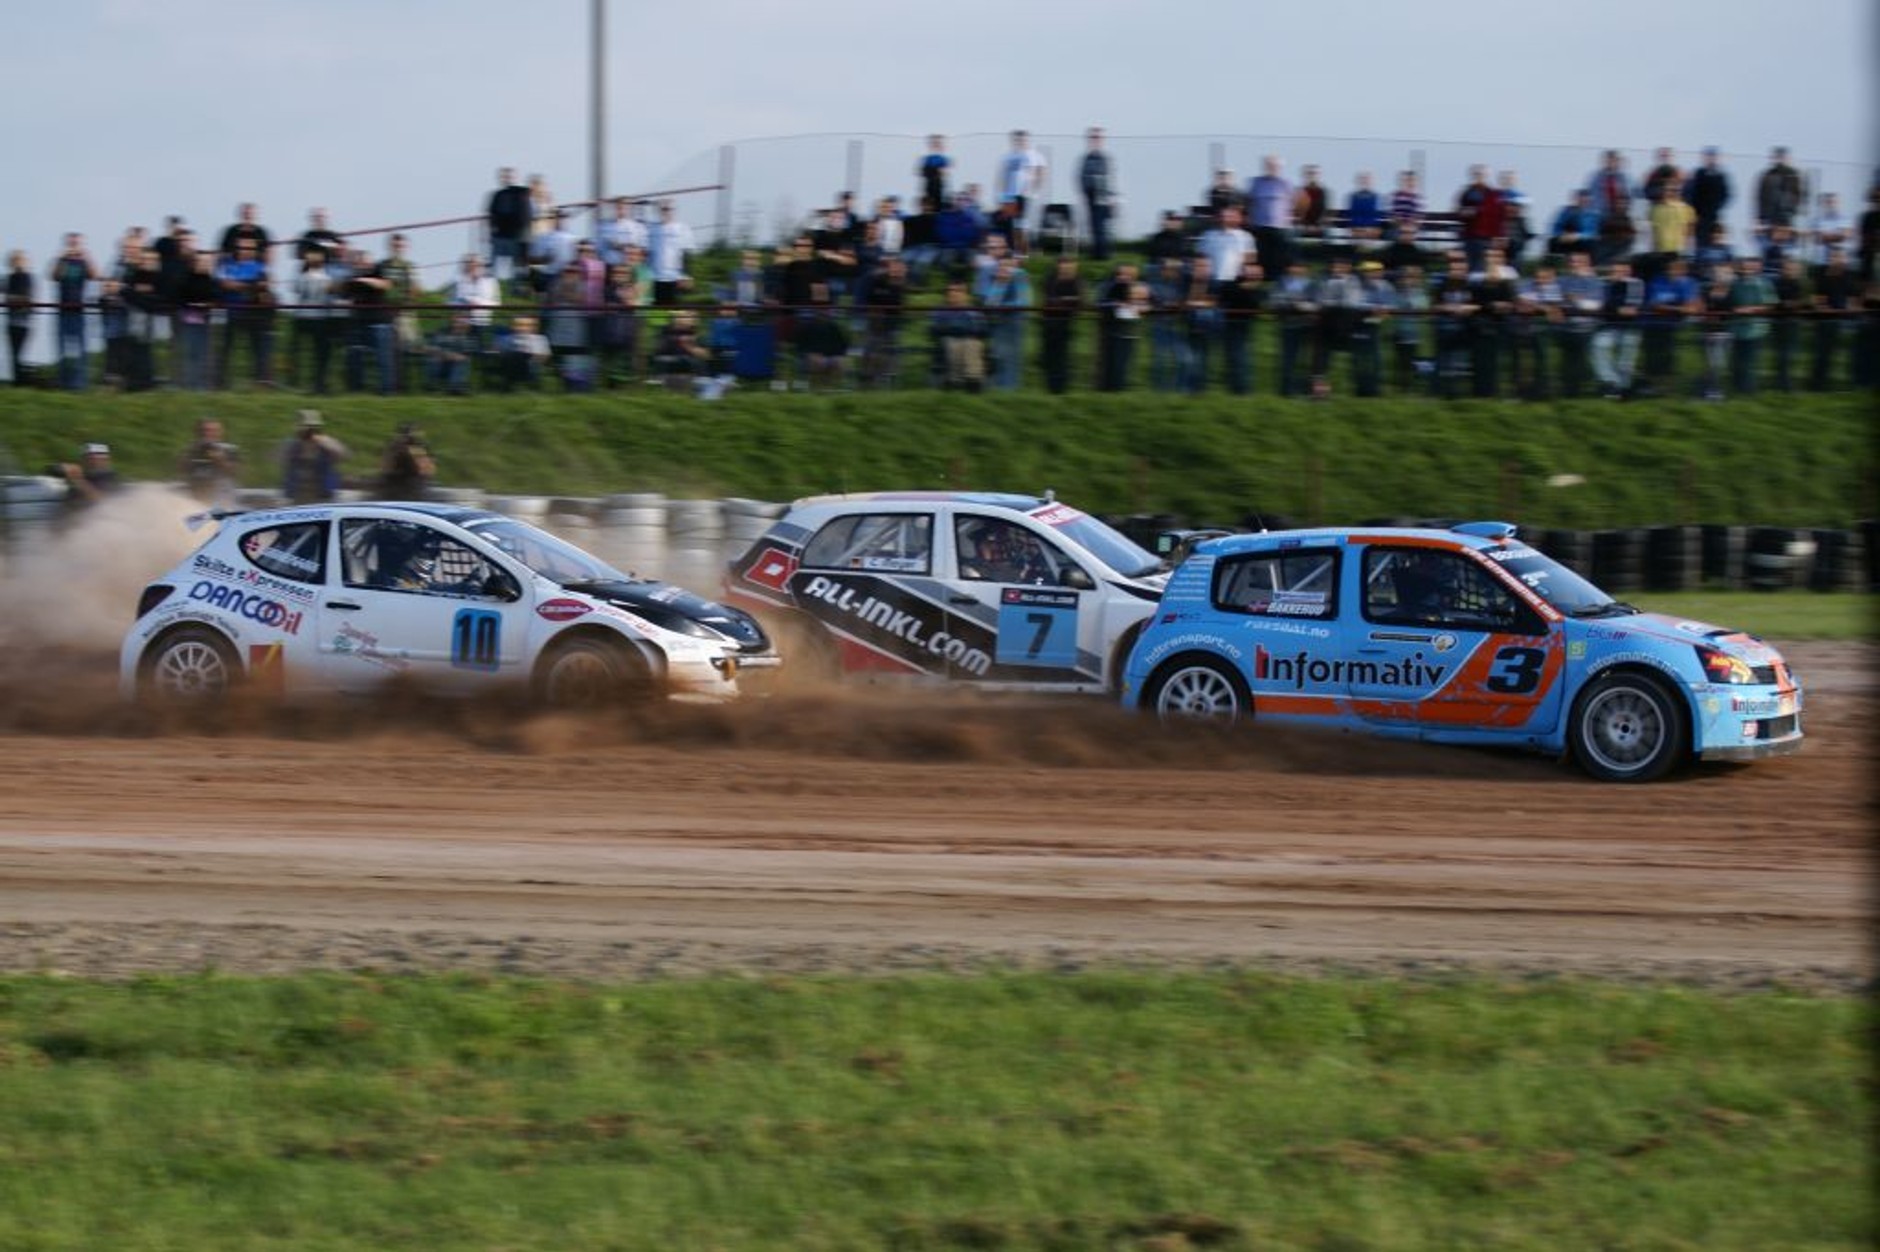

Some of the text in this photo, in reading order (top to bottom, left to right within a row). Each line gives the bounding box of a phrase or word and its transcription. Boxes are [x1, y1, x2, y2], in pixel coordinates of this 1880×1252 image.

[193, 554, 236, 576] Skilte
[455, 613, 498, 665] 10
[1027, 613, 1054, 659] 7
[1255, 644, 1446, 690] Informativ
[1486, 646, 1545, 694] 3
